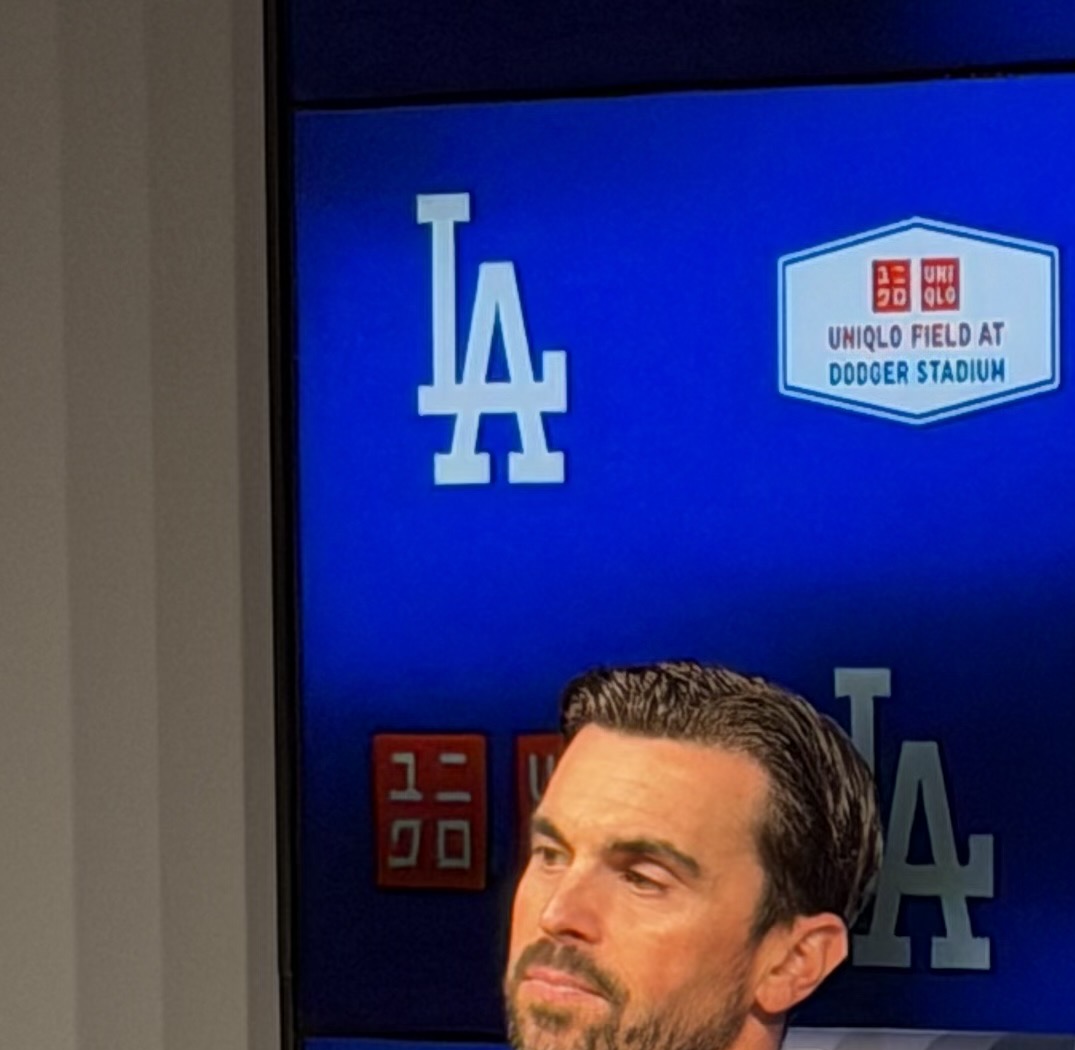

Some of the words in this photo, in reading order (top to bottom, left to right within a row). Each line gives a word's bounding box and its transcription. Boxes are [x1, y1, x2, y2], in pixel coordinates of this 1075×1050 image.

[416, 193, 568, 486] LA
[828, 325, 902, 352] UNIQLO
[911, 323, 972, 348] FIELD
[978, 321, 1005, 346] AT
[829, 362, 909, 387] DODGER
[917, 358, 1006, 383] STADIUM
